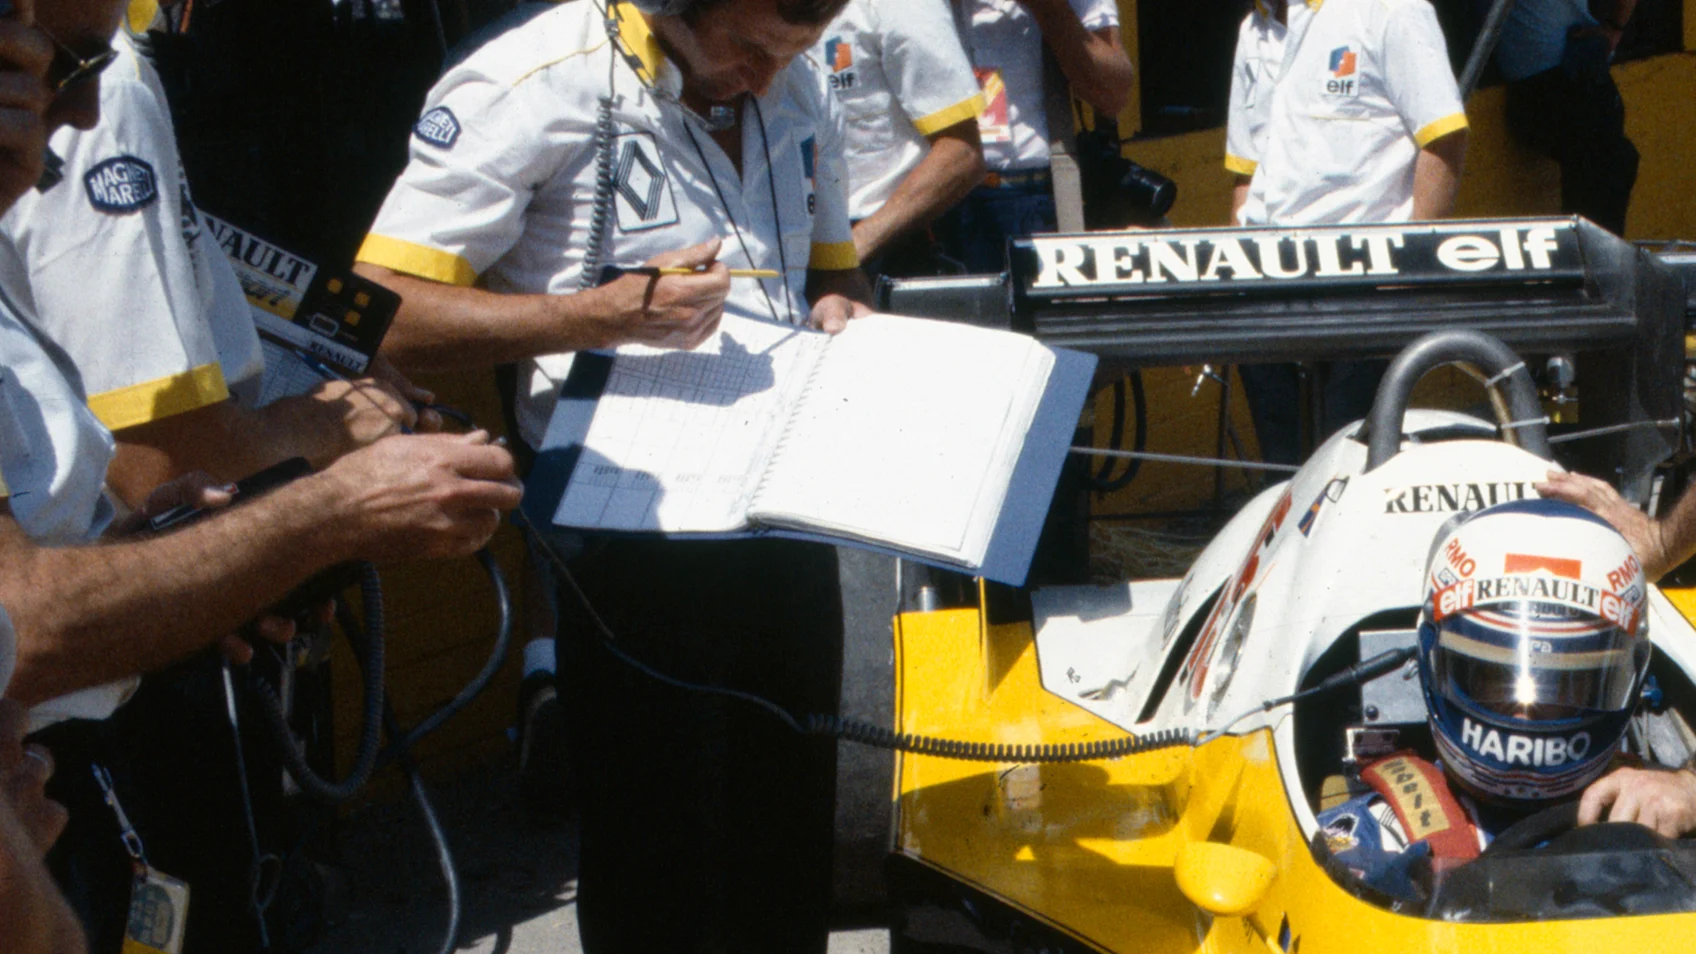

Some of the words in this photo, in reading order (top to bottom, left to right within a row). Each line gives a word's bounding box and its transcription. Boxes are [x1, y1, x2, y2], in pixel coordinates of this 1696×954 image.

[1327, 80, 1354, 94] elf
[1032, 233, 1405, 289] RENAULT
[1437, 228, 1559, 272] elf
[1446, 537, 1477, 578] RMO
[1606, 553, 1641, 593] RMO
[1440, 581, 1473, 615] elf
[1476, 576, 1602, 609] RENAULT
[1601, 597, 1634, 633] elf
[1461, 717, 1592, 768] HARIBO
